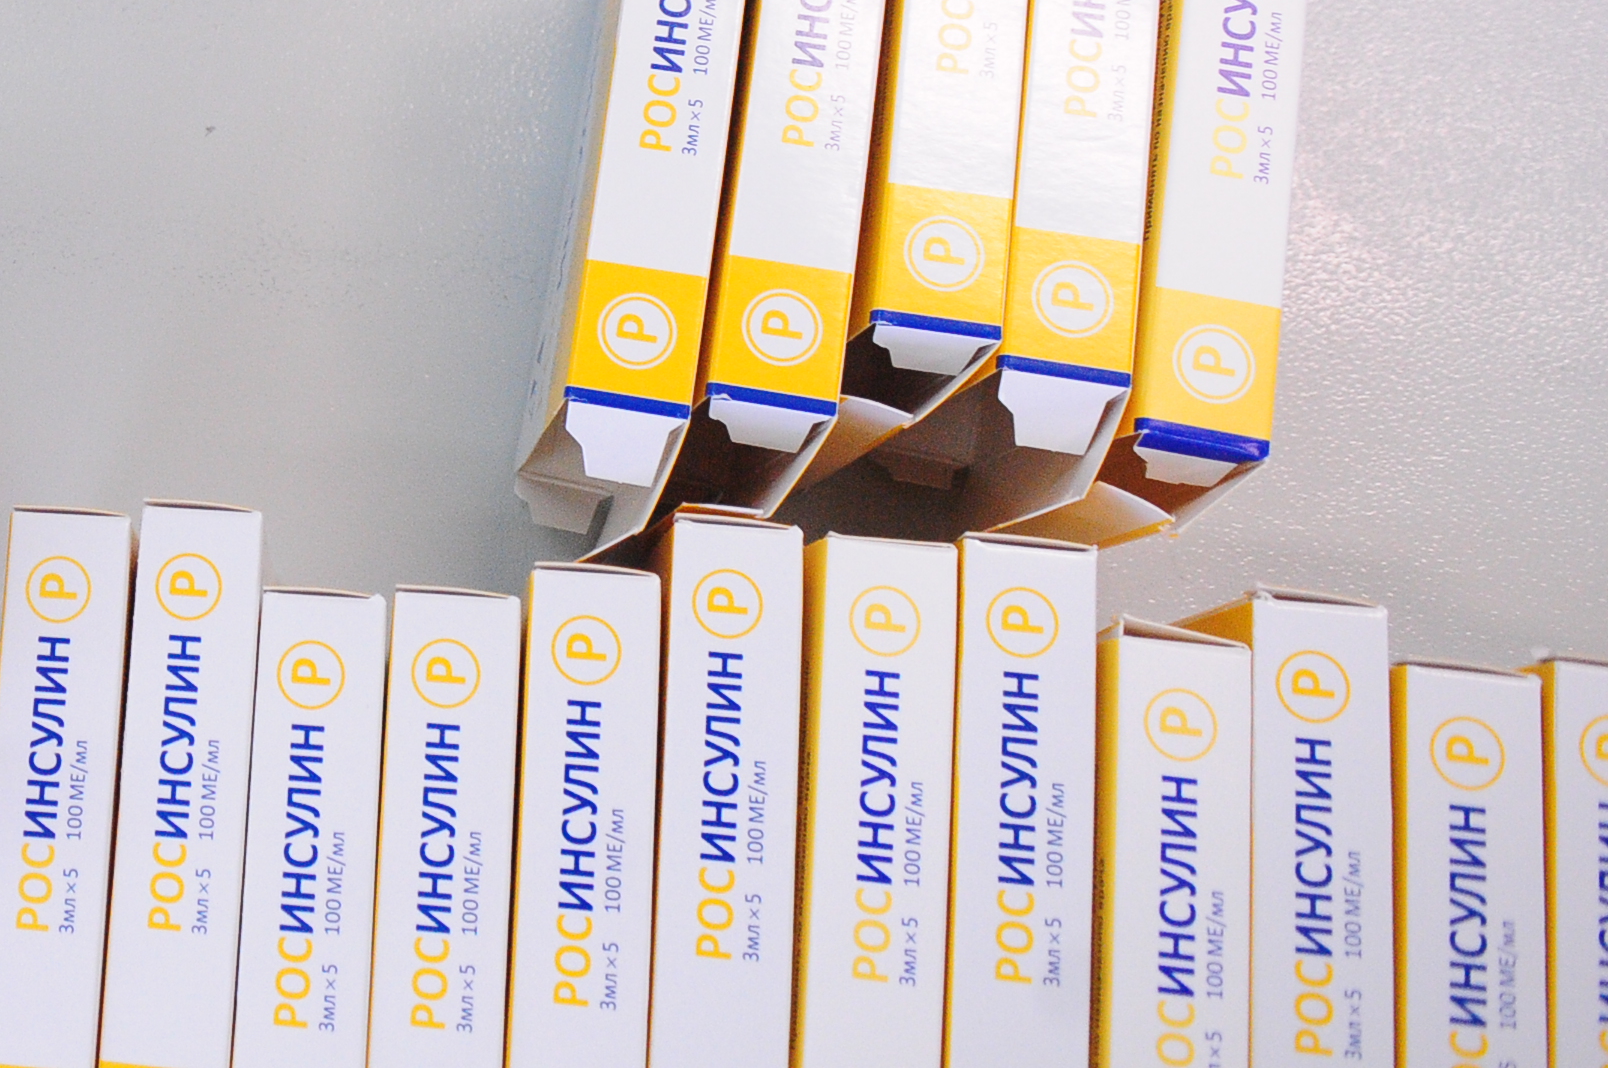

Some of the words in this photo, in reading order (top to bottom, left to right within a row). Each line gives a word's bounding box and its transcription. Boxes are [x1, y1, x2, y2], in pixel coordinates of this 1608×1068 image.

[693, 44, 710, 74] 100
[834, 40, 852, 70] 100
[1263, 11, 1284, 65] МЕ/мл
[1260, 69, 1278, 100] 100
[16, 635, 70, 931] РОСИНСУЛИН
[68, 740, 90, 801] МЕ/мл
[148, 633, 202, 931] РОСИНСУЛИН
[200, 739, 222, 800] МЕ/мл
[746, 760, 768, 823] МЕ/мл
[66, 804, 83, 839] 100
[198, 804, 215, 840] 100
[695, 651, 743, 960] РОСИНСУЛИН
[851, 669, 900, 982] РОСИНСУЛИН
[903, 780, 925, 844] МЕ/мл
[994, 670, 1039, 984] РОСИНСУЛИН
[1046, 782, 1066, 845] МЕ/мл
[326, 831, 347, 893] МЕ/мл
[463, 831, 484, 893] МЕ/мл
[552, 698, 602, 1007] РОСИНСУЛИН
[604, 808, 626, 871] МЕ/мл
[746, 827, 763, 863] 100
[903, 849, 920, 885] 100
[1046, 851, 1062, 887] 100
[273, 723, 324, 1028] РОСИНСУЛИН
[409, 722, 461, 1029] РОСИНСУЛИН
[604, 876, 621, 913] 100
[1295, 736, 1333, 1056] РОСИНСУЛИН
[1344, 850, 1363, 916] МЕ/мл
[324, 898, 341, 935] 100
[461, 898, 479, 935] 100
[1156, 775, 1198, 1067] ОСИНСУЛИН
[1206, 891, 1226, 955] МЕ/мл
[1345, 921, 1361, 957] 100
[1450, 804, 1487, 1067] СИНСУЛИН
[1206, 962, 1223, 998] 100
[1500, 994, 1515, 1028] 100
